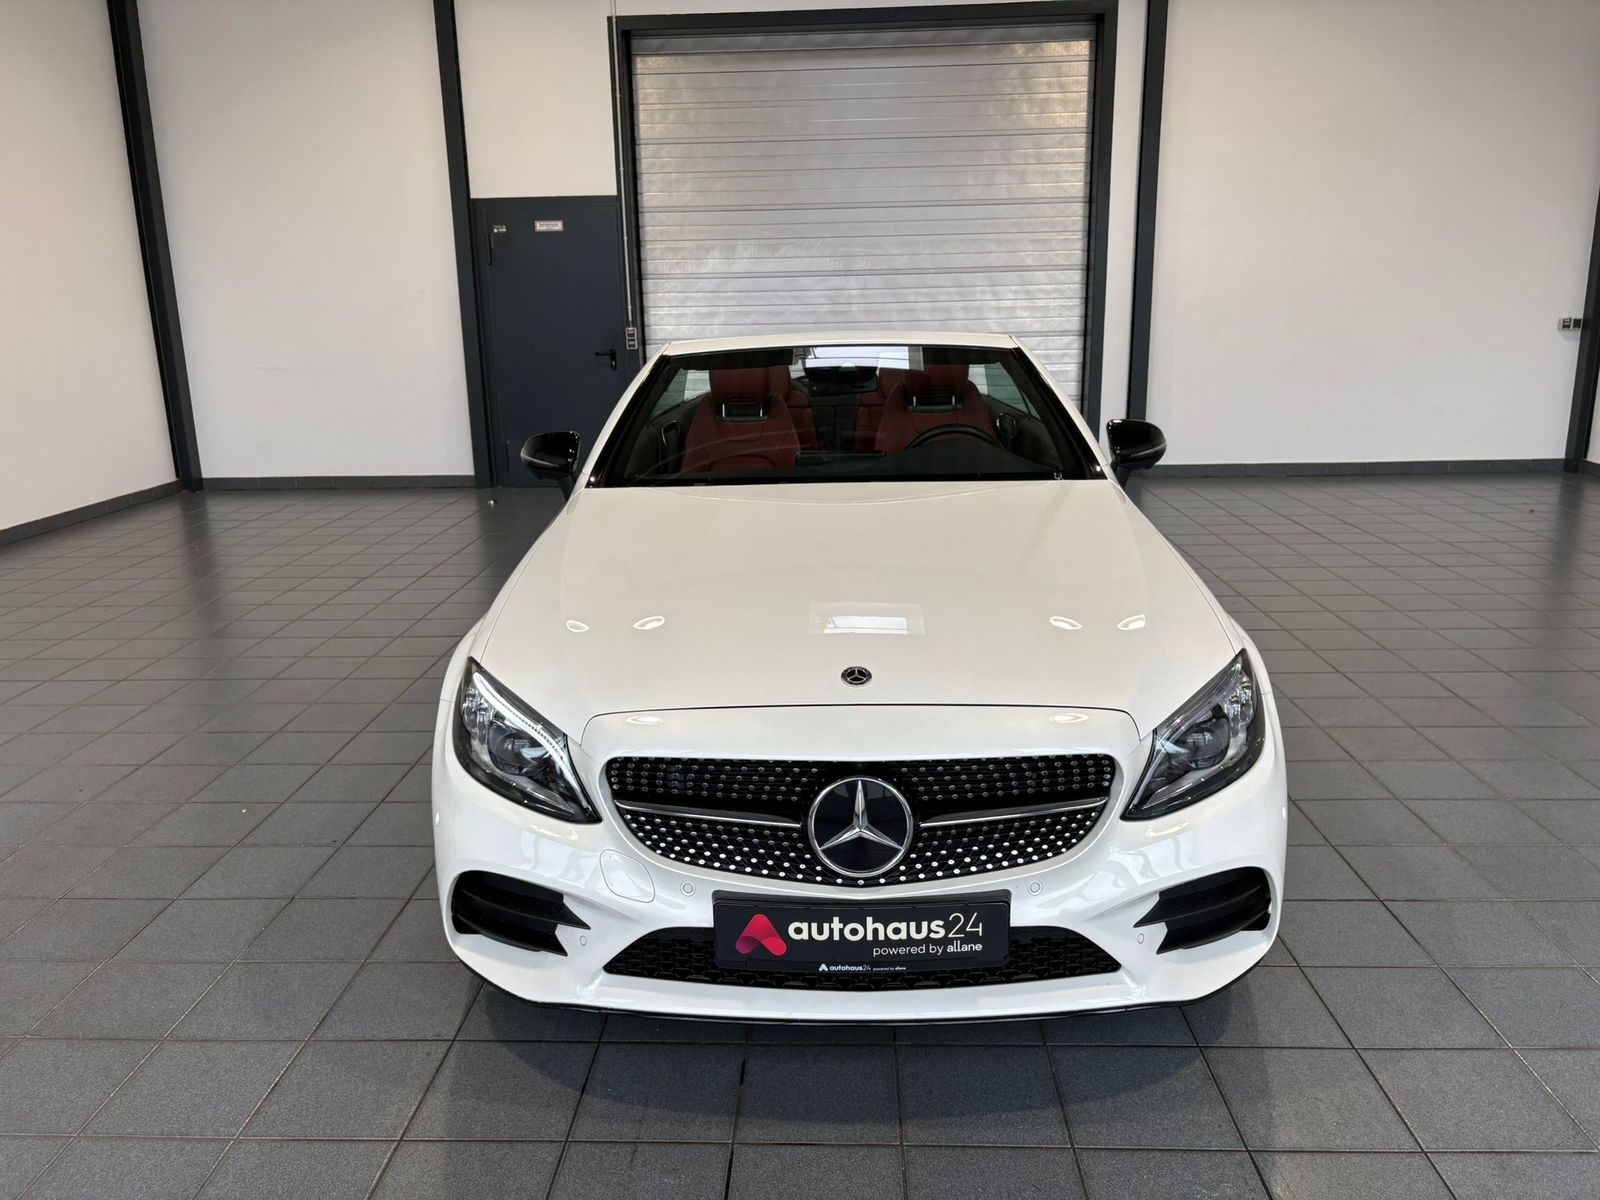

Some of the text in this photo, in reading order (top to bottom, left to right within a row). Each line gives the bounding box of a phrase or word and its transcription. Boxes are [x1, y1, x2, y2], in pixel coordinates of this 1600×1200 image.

[788, 912, 983, 942] autohaus24
[873, 940, 983, 958] powered by allane
